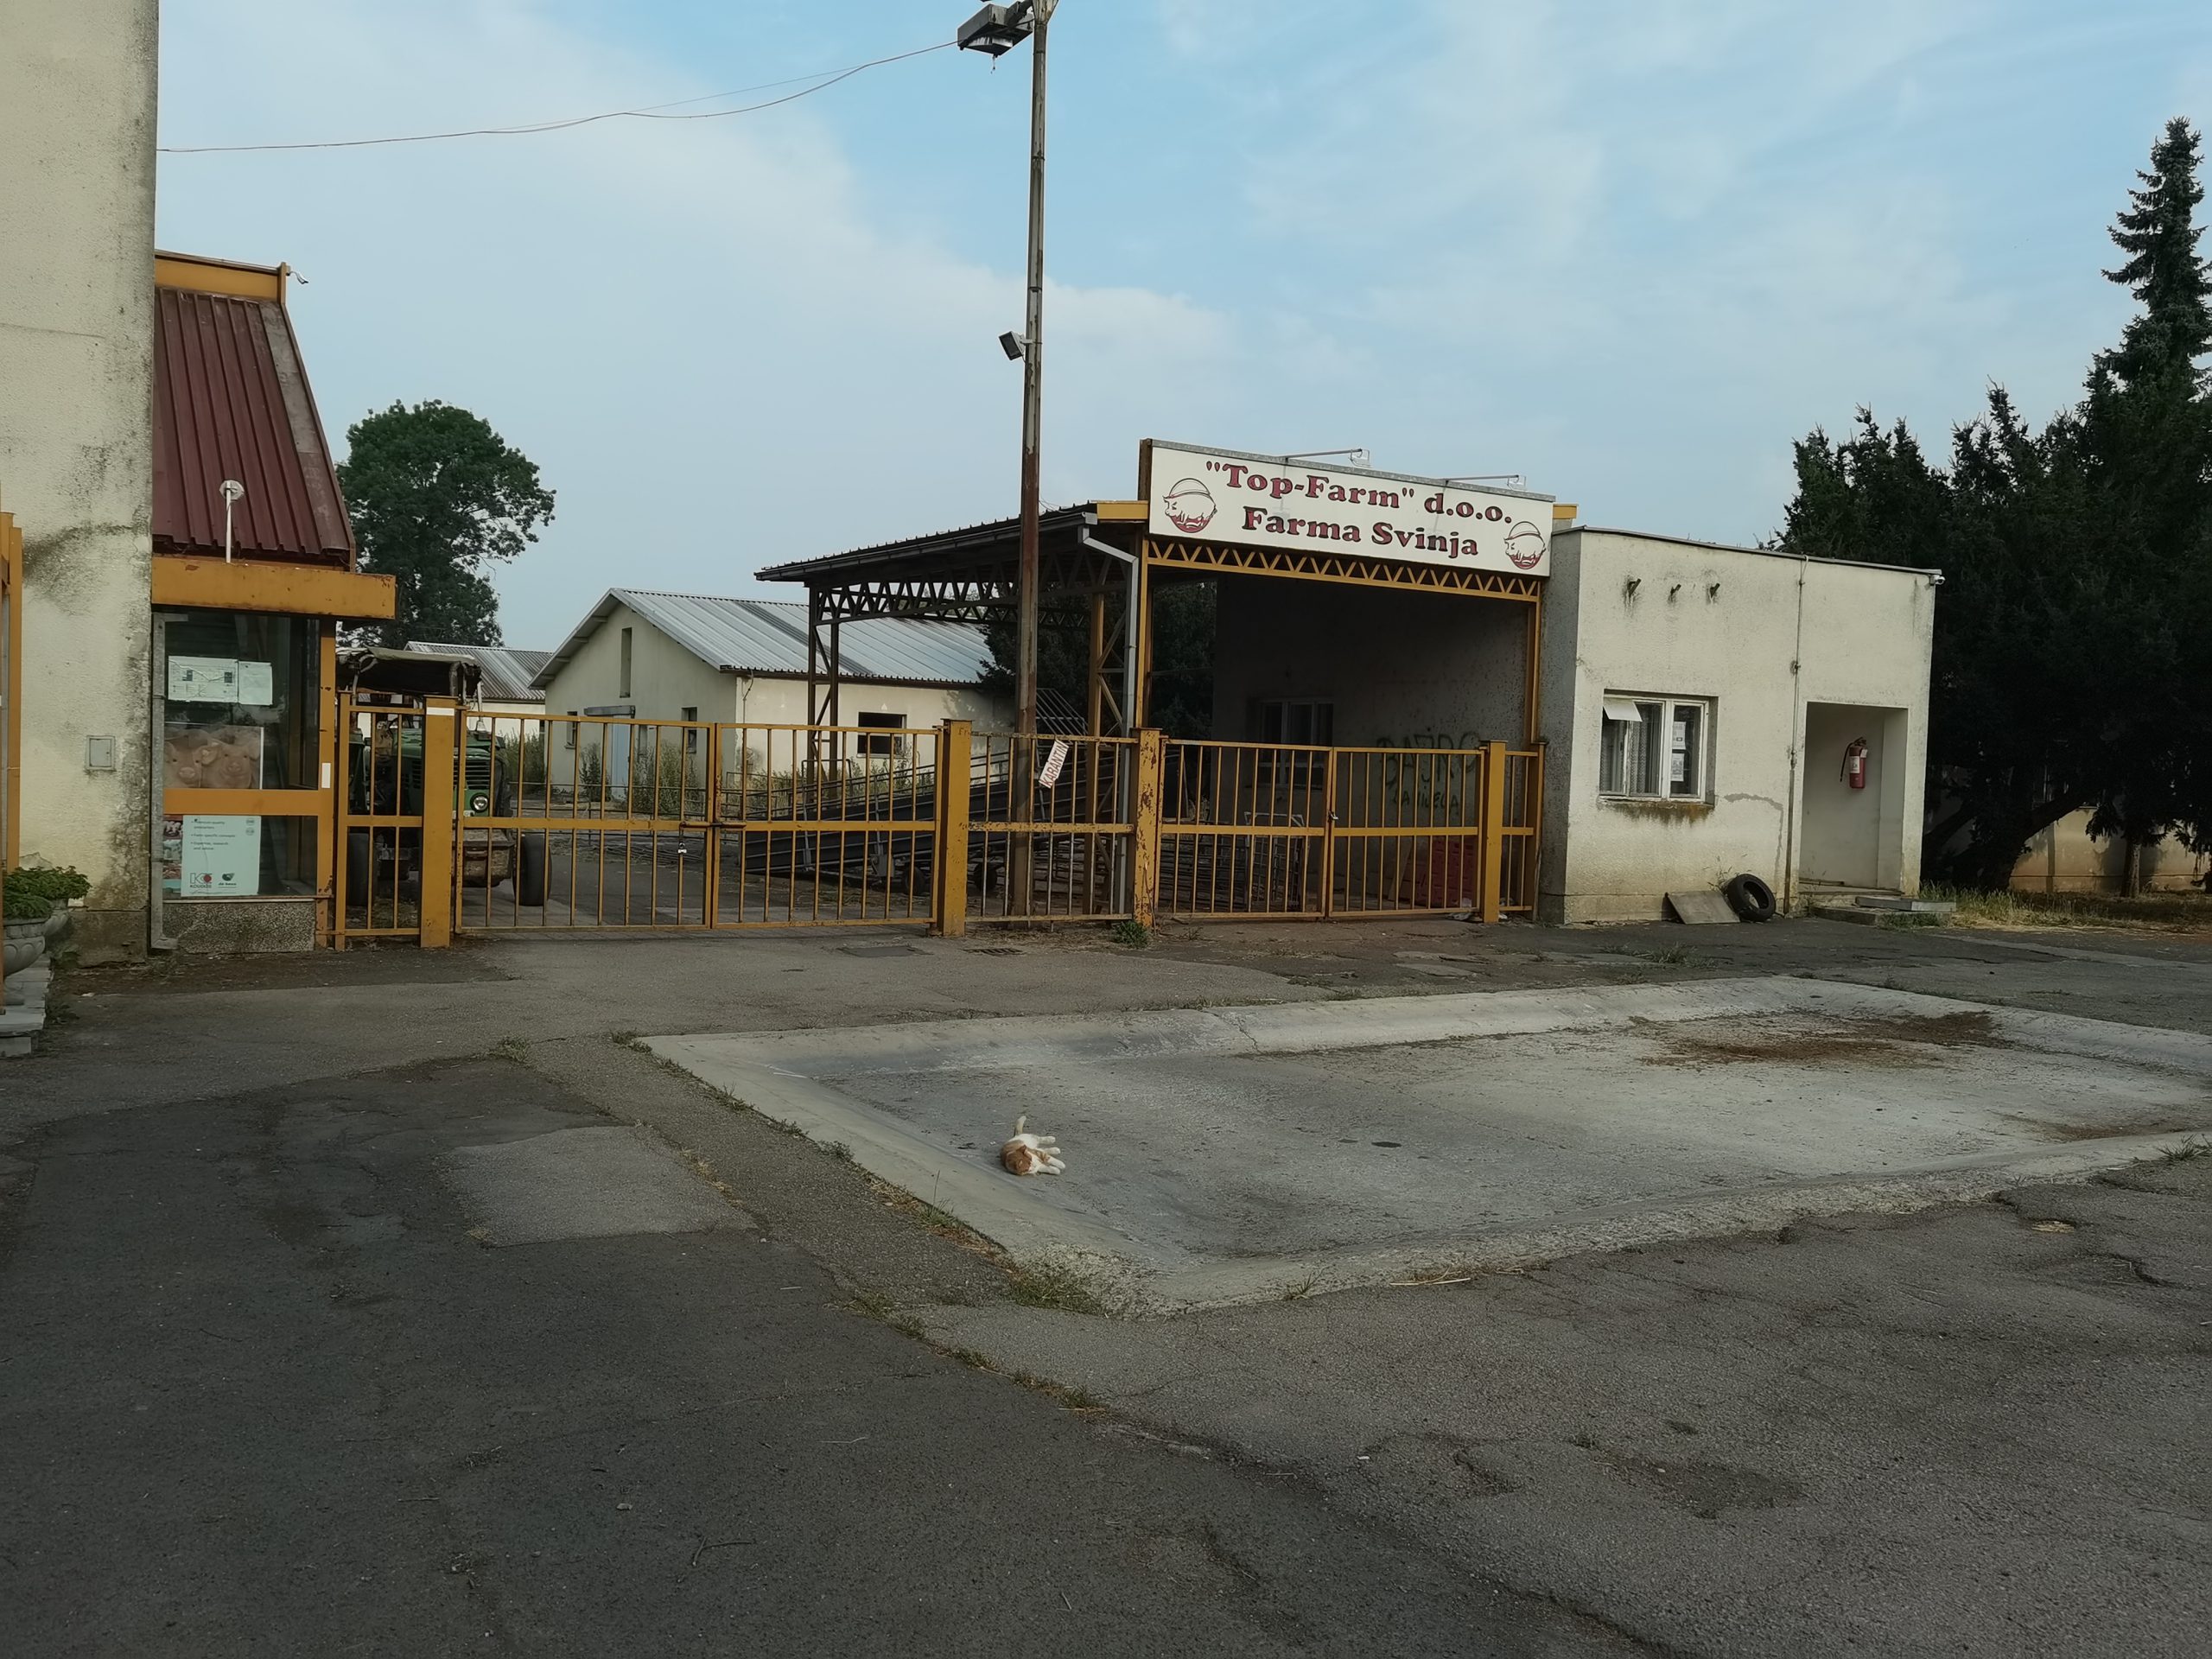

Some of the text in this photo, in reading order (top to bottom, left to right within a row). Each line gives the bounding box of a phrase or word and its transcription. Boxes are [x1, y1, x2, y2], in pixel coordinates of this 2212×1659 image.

[1206, 461, 1512, 524] "Top-Farm" d.o.o.
[1242, 505, 1478, 558] Farma Svinja
[1039, 741, 1068, 787] KARANTIN
